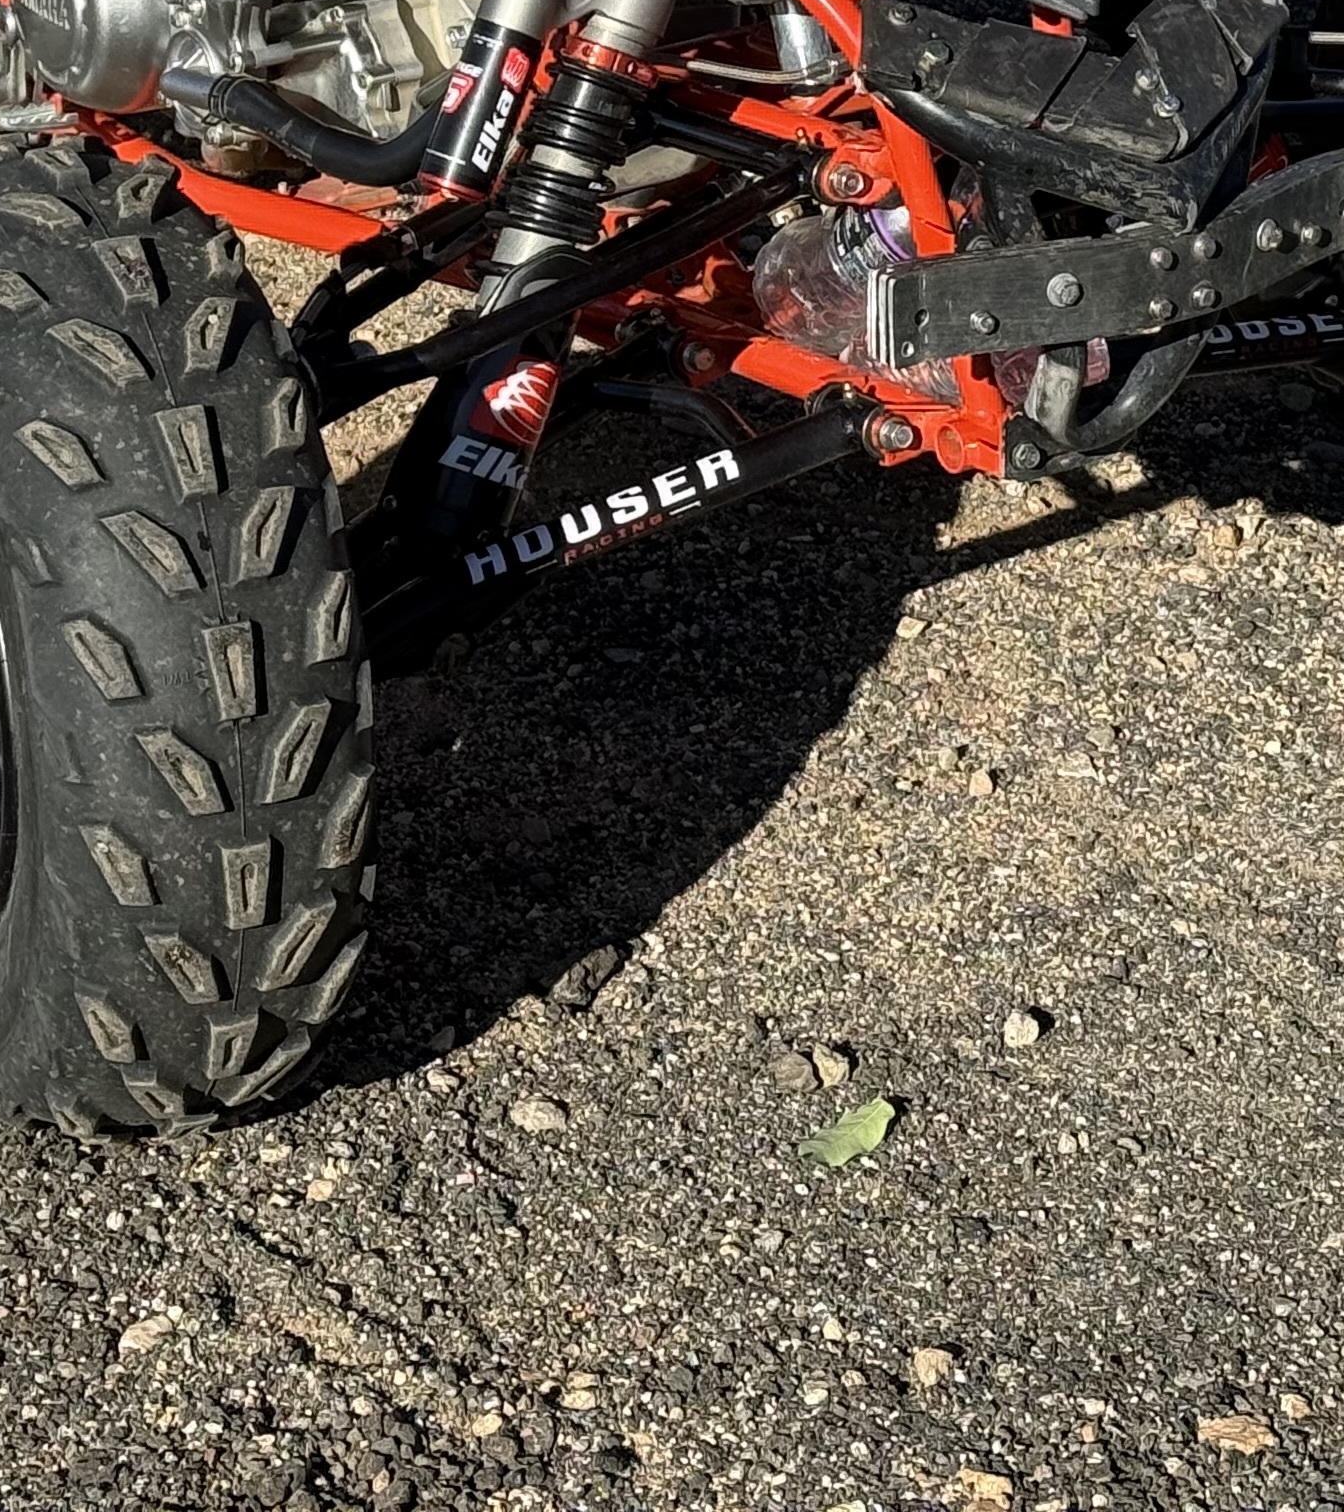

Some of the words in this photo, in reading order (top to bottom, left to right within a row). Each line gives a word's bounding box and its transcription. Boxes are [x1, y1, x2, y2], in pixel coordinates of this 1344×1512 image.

[472, 88, 515, 173] Elka
[438, 434, 526, 489] Elk
[464, 449, 740, 585] HOUSER
[563, 513, 664, 567] RACING
